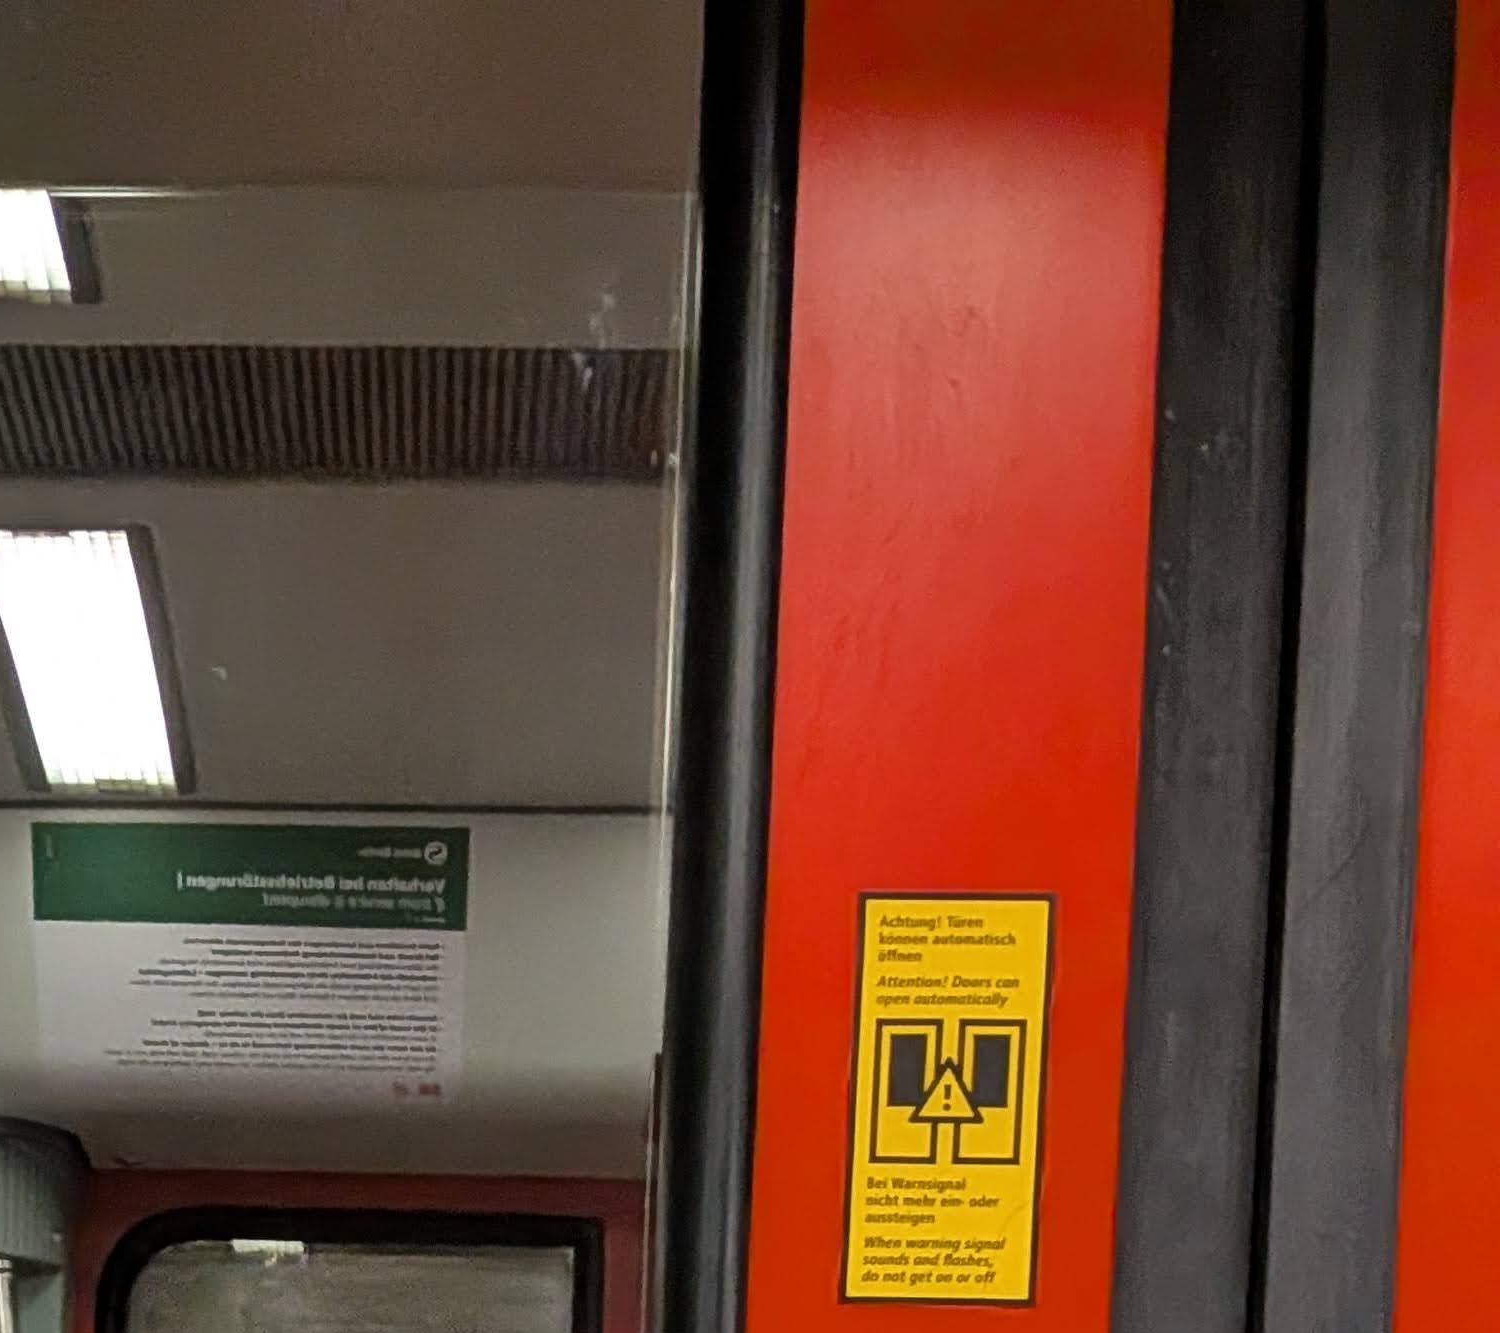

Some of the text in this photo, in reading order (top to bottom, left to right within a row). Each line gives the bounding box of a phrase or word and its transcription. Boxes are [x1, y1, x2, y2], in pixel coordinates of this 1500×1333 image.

[880, 915, 984, 931] Achtung! Türen
[879, 932, 1016, 945] können automatisch
[878, 950, 922, 962] öffnen
[876, 975, 1020, 988] Attention! Doors can
[876, 993, 1008, 1008] open automatically
[867, 1177, 966, 1192] Bei Warnsignal
[866, 1195, 1000, 1207] nicht mehr ein- oder
[865, 1213, 936, 1226] aussteigen
[864, 1236, 1006, 1252] When warning signal
[863, 1254, 994, 1268] sounds and flashes,
[862, 1270, 996, 1286] do not get on or off
